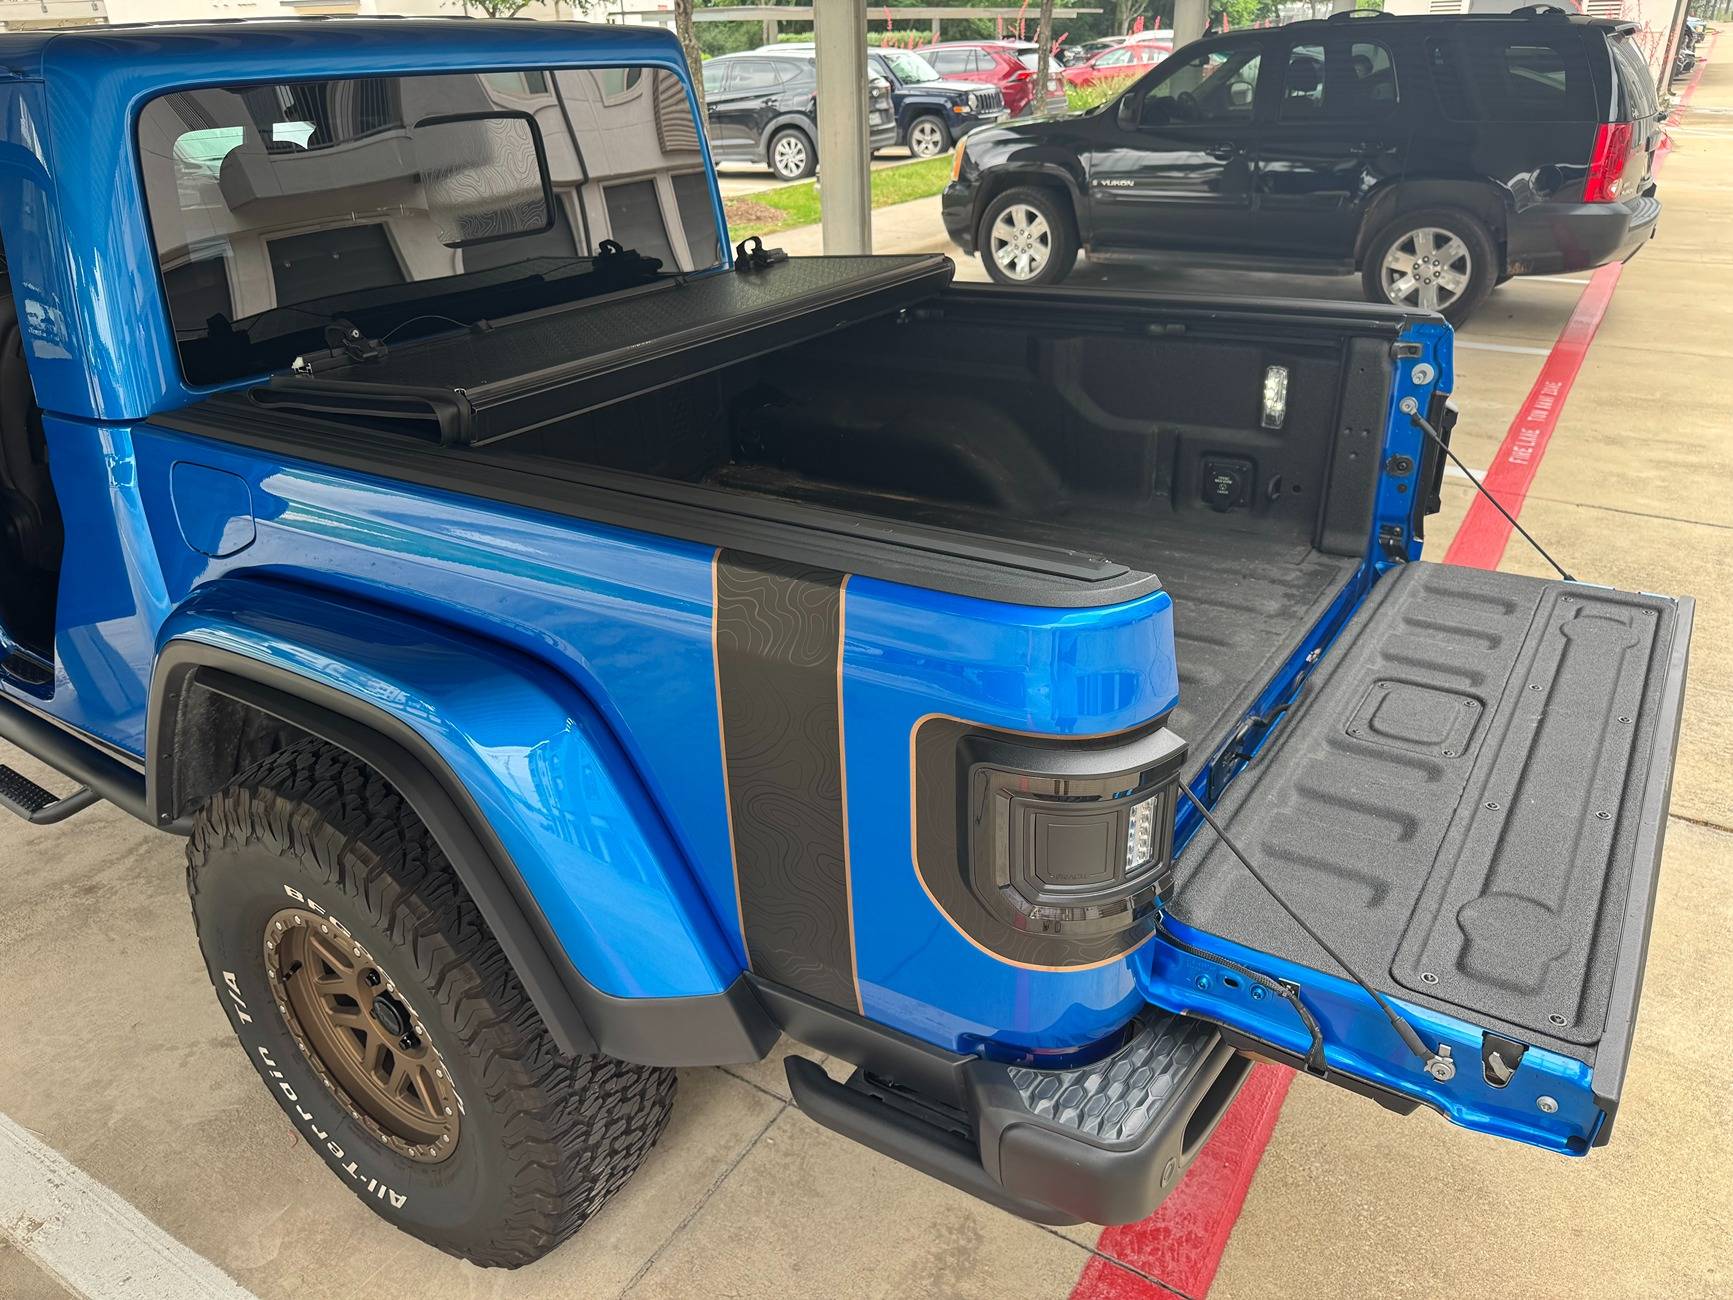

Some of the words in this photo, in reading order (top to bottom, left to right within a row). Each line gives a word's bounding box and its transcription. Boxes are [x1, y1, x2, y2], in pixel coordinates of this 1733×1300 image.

[1100, 179, 1135, 187] YUKON
[1515, 428, 1540, 447] LANE
[1508, 446, 1533, 464] FIRE
[222, 971, 252, 1025] T/A
[258, 1046, 407, 1209] All-Terrain
